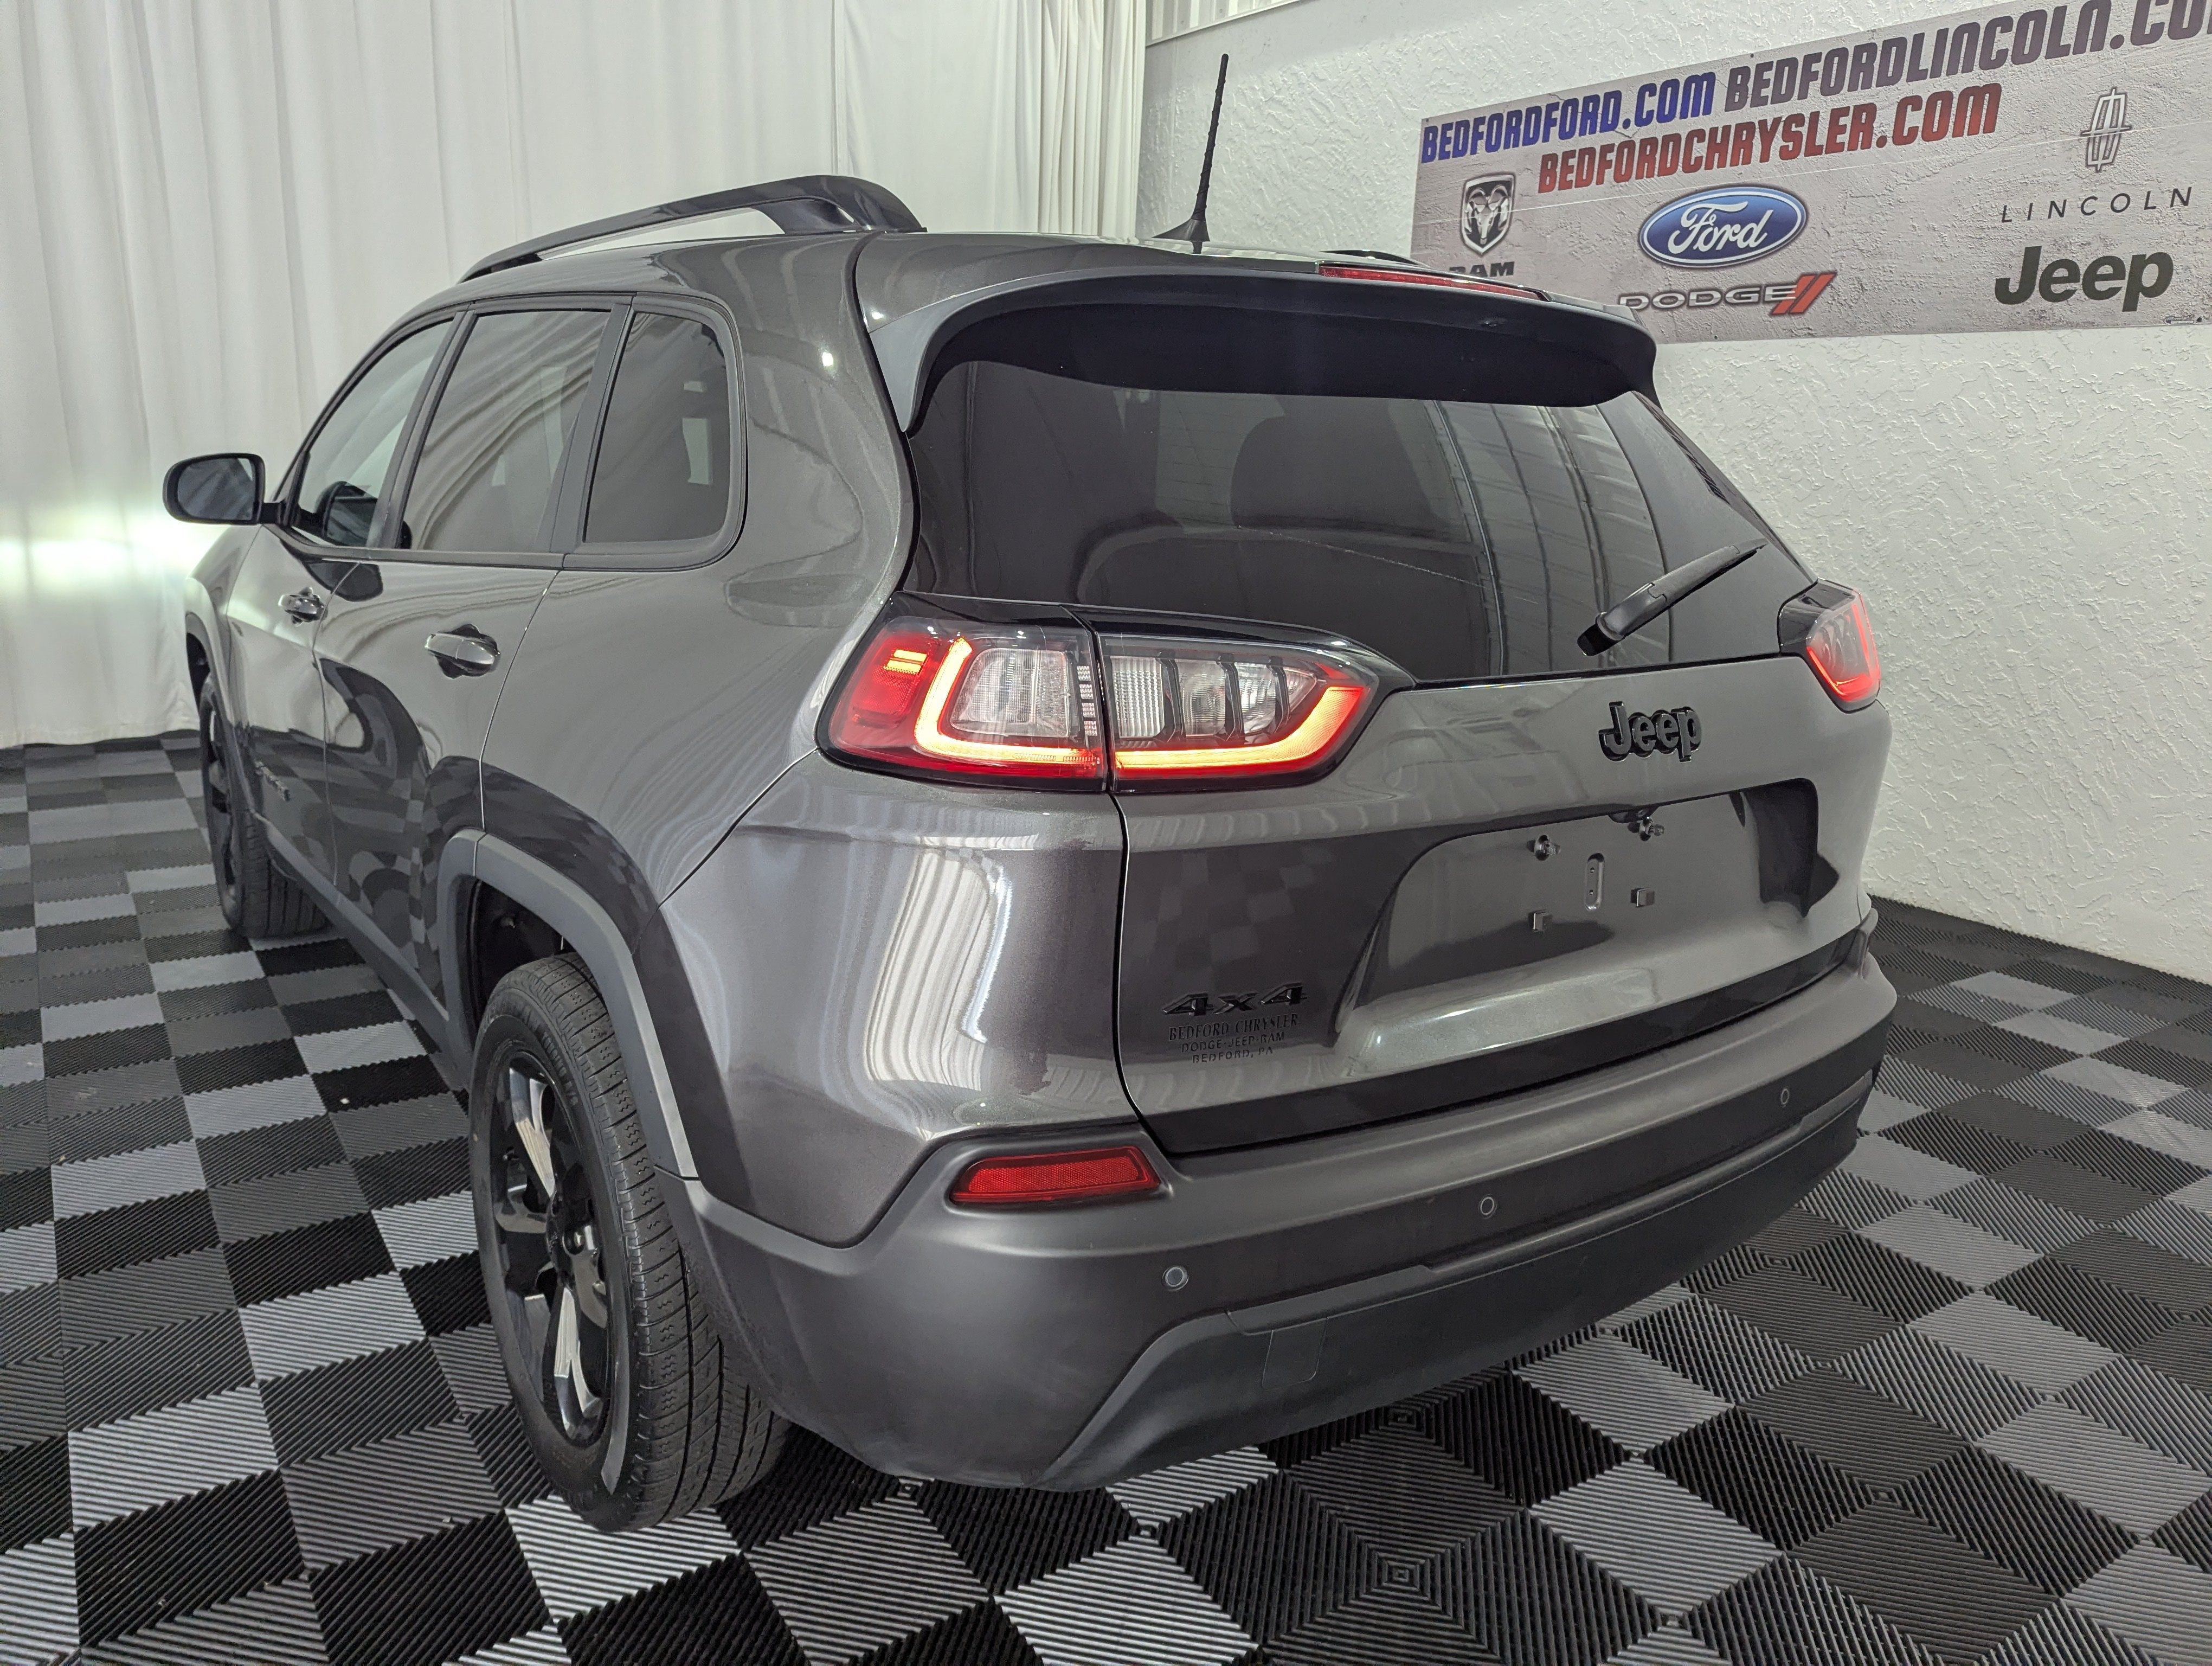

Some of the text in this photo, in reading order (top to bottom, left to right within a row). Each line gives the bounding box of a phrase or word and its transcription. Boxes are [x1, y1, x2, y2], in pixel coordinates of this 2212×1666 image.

[1421, 0, 2212, 163] BEDFORDFORD.COM BEDFORDLINCOLN.CO
[1538, 82, 2002, 194] BEDFORDCHRYSLER.COM
[1668, 201, 1774, 254] Ford
[2001, 187, 2192, 223] LINCOLN
[1619, 284, 1798, 310] DODGE
[1994, 245, 2174, 312] Jeep
[1598, 701, 1702, 762] Jeep
[1169, 1021, 1229, 1041] BEDFORD
[1193, 1046, 1273, 1063] BEDFORD, PA
